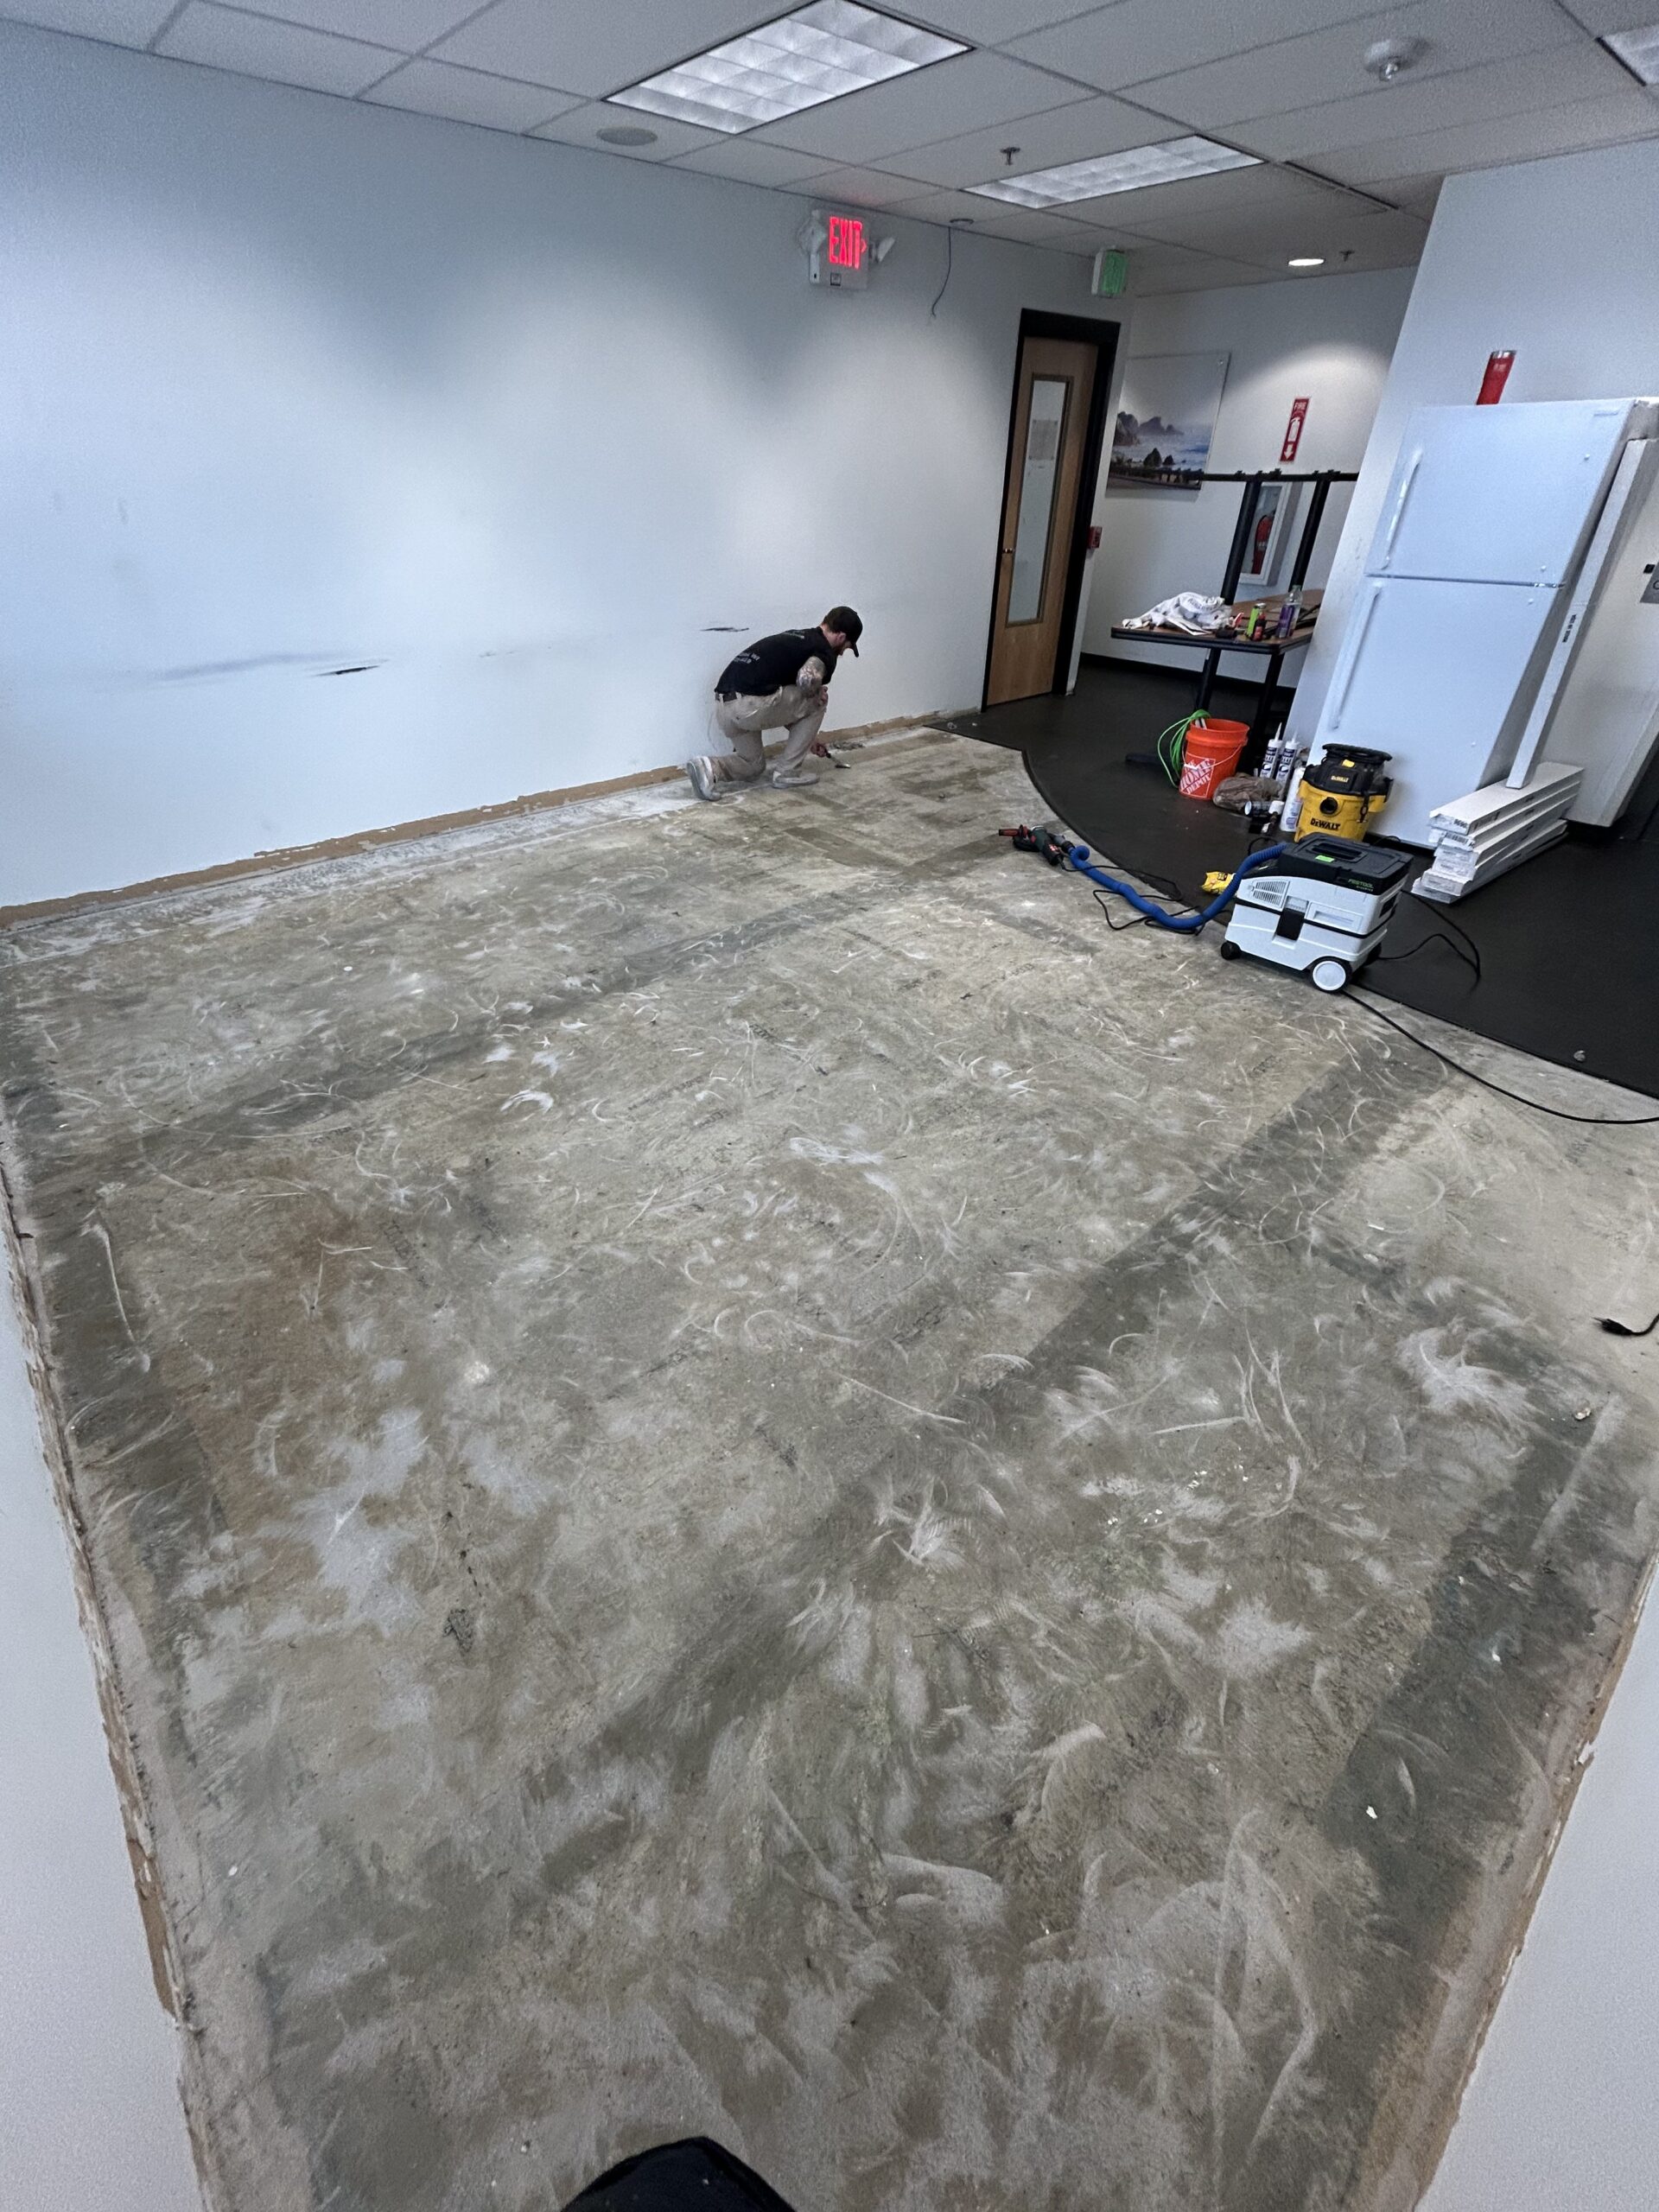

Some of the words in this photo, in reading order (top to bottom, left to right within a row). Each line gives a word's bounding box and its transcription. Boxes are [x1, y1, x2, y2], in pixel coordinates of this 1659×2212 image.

[830, 216, 862, 270] EXIT
[1179, 759, 1212, 792] HOME
[1186, 773, 1211, 795] DEPOT
[1311, 817, 1341, 831] DEWALT
